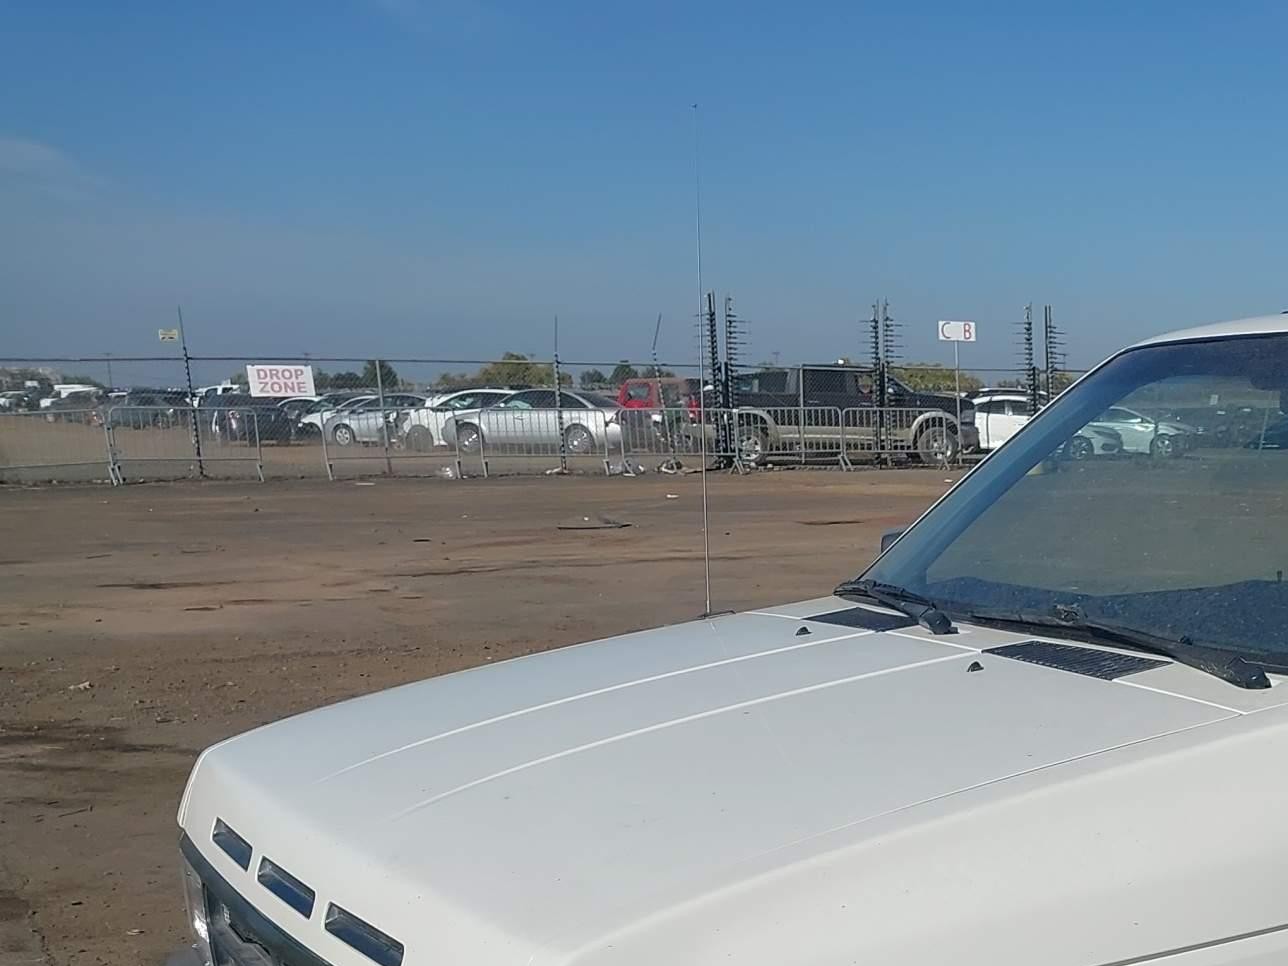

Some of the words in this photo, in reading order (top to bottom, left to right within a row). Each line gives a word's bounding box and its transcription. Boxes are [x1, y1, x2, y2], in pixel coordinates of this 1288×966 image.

[963, 323, 972, 340] B
[256, 368, 304, 381] DROP
[258, 381, 308, 394] ZONE
